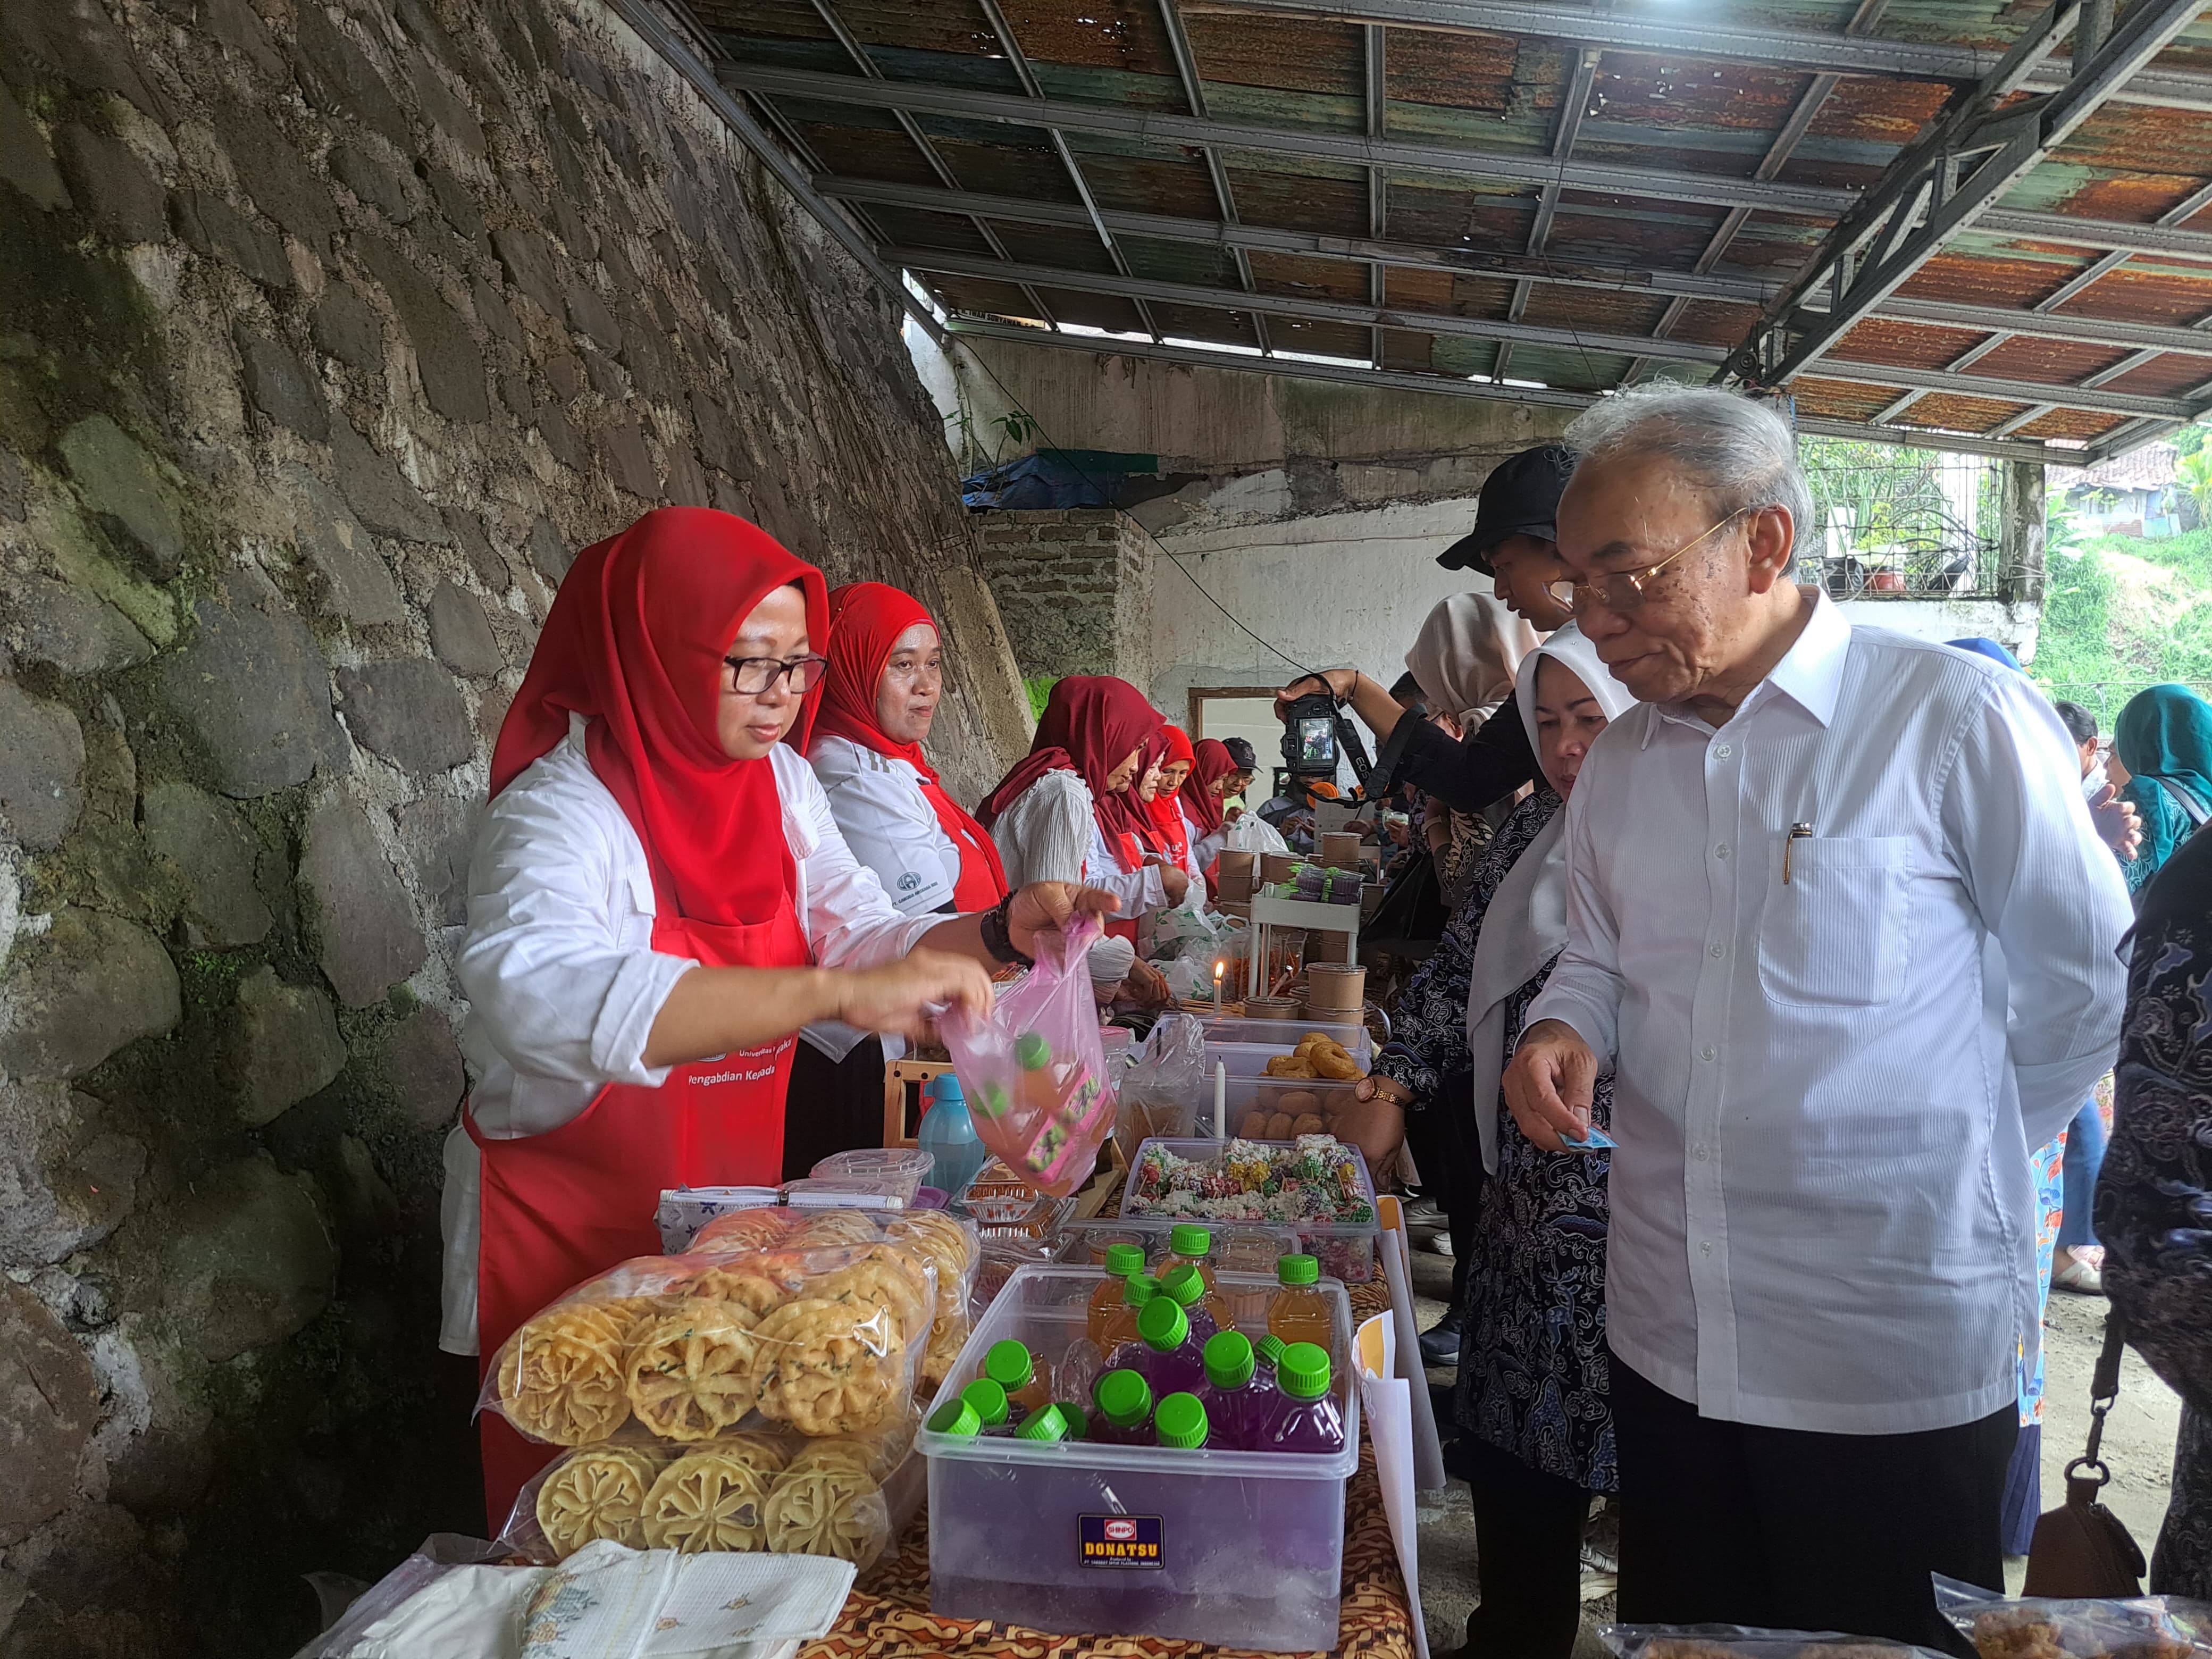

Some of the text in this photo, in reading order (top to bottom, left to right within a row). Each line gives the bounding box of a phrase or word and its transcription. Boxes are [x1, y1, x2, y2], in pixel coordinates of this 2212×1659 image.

[969, 310, 986, 320] IWAN
[1355, 757, 1370, 779] EOS
[689, 1070, 742, 1086] Pengabdian
[745, 1065, 775, 1081] Kepada
[1085, 1541, 1158, 1557] DONATSU
